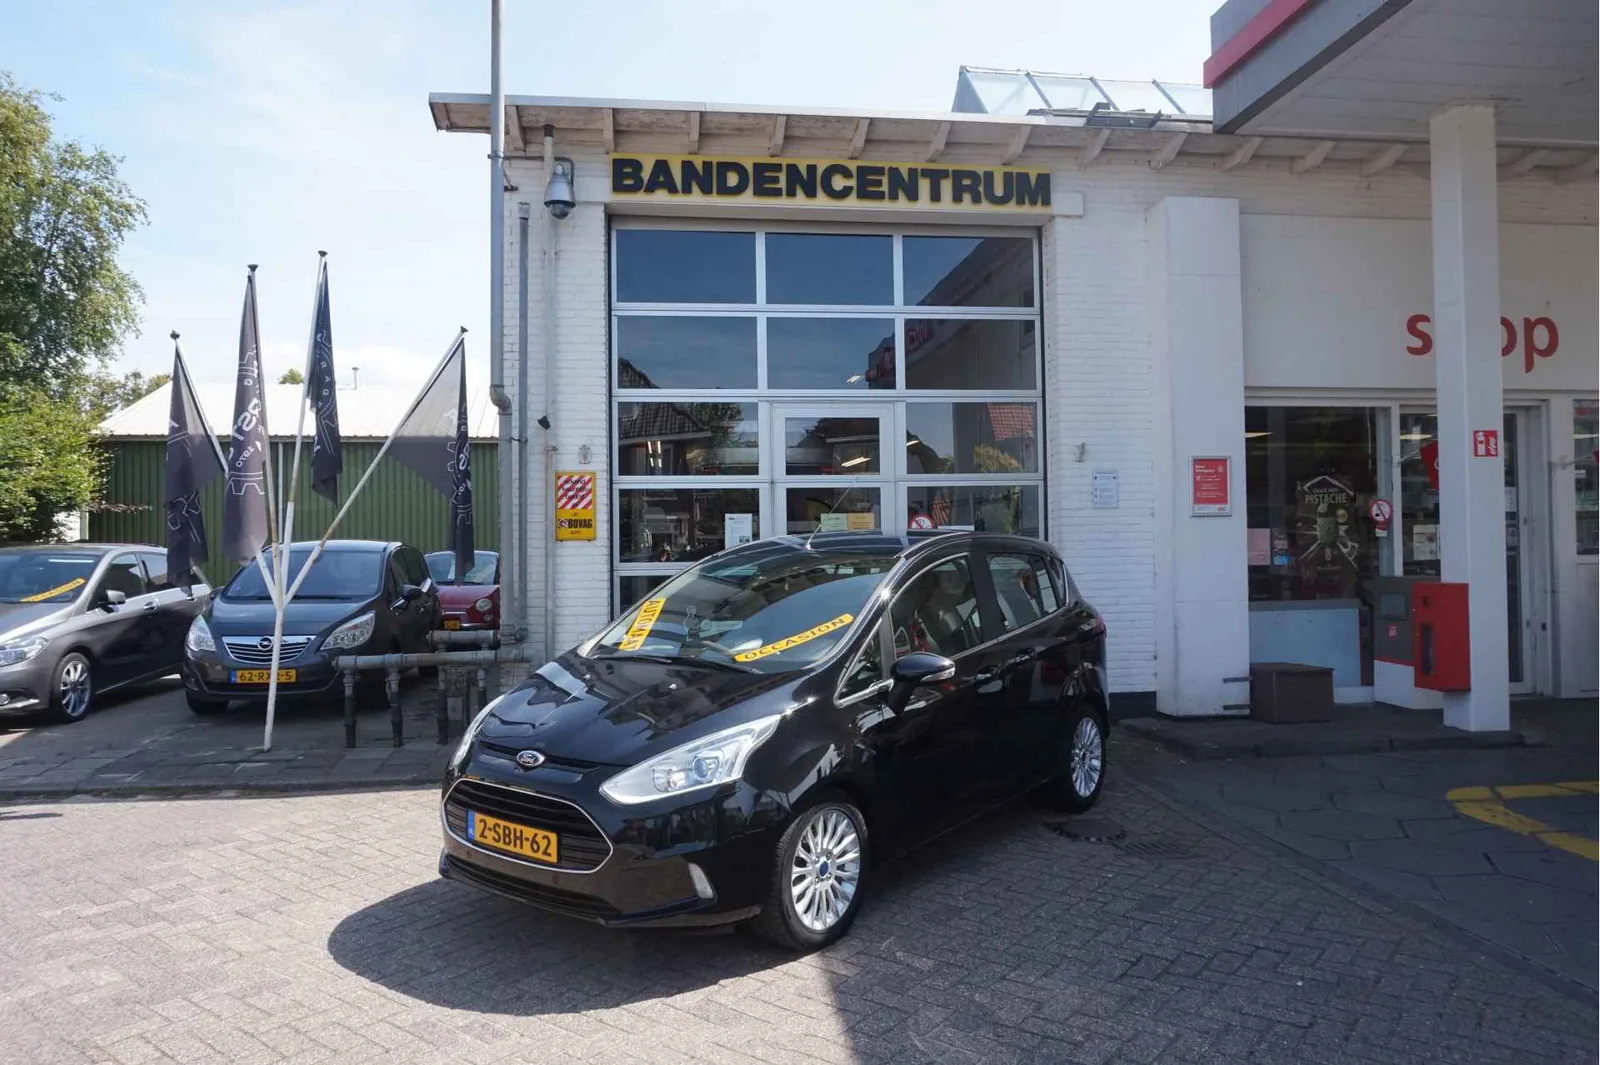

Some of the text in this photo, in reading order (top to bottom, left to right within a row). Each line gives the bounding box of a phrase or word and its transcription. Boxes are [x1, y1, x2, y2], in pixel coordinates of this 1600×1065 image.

[611, 158, 1051, 206] BANDENCENTRUM
[1406, 314, 1559, 374] sp
[1304, 493, 1347, 504] PISTACHE
[567, 518, 593, 529] BOVAG
[744, 618, 845, 660] OCCASION
[478, 818, 552, 857] 2-SBH-62
